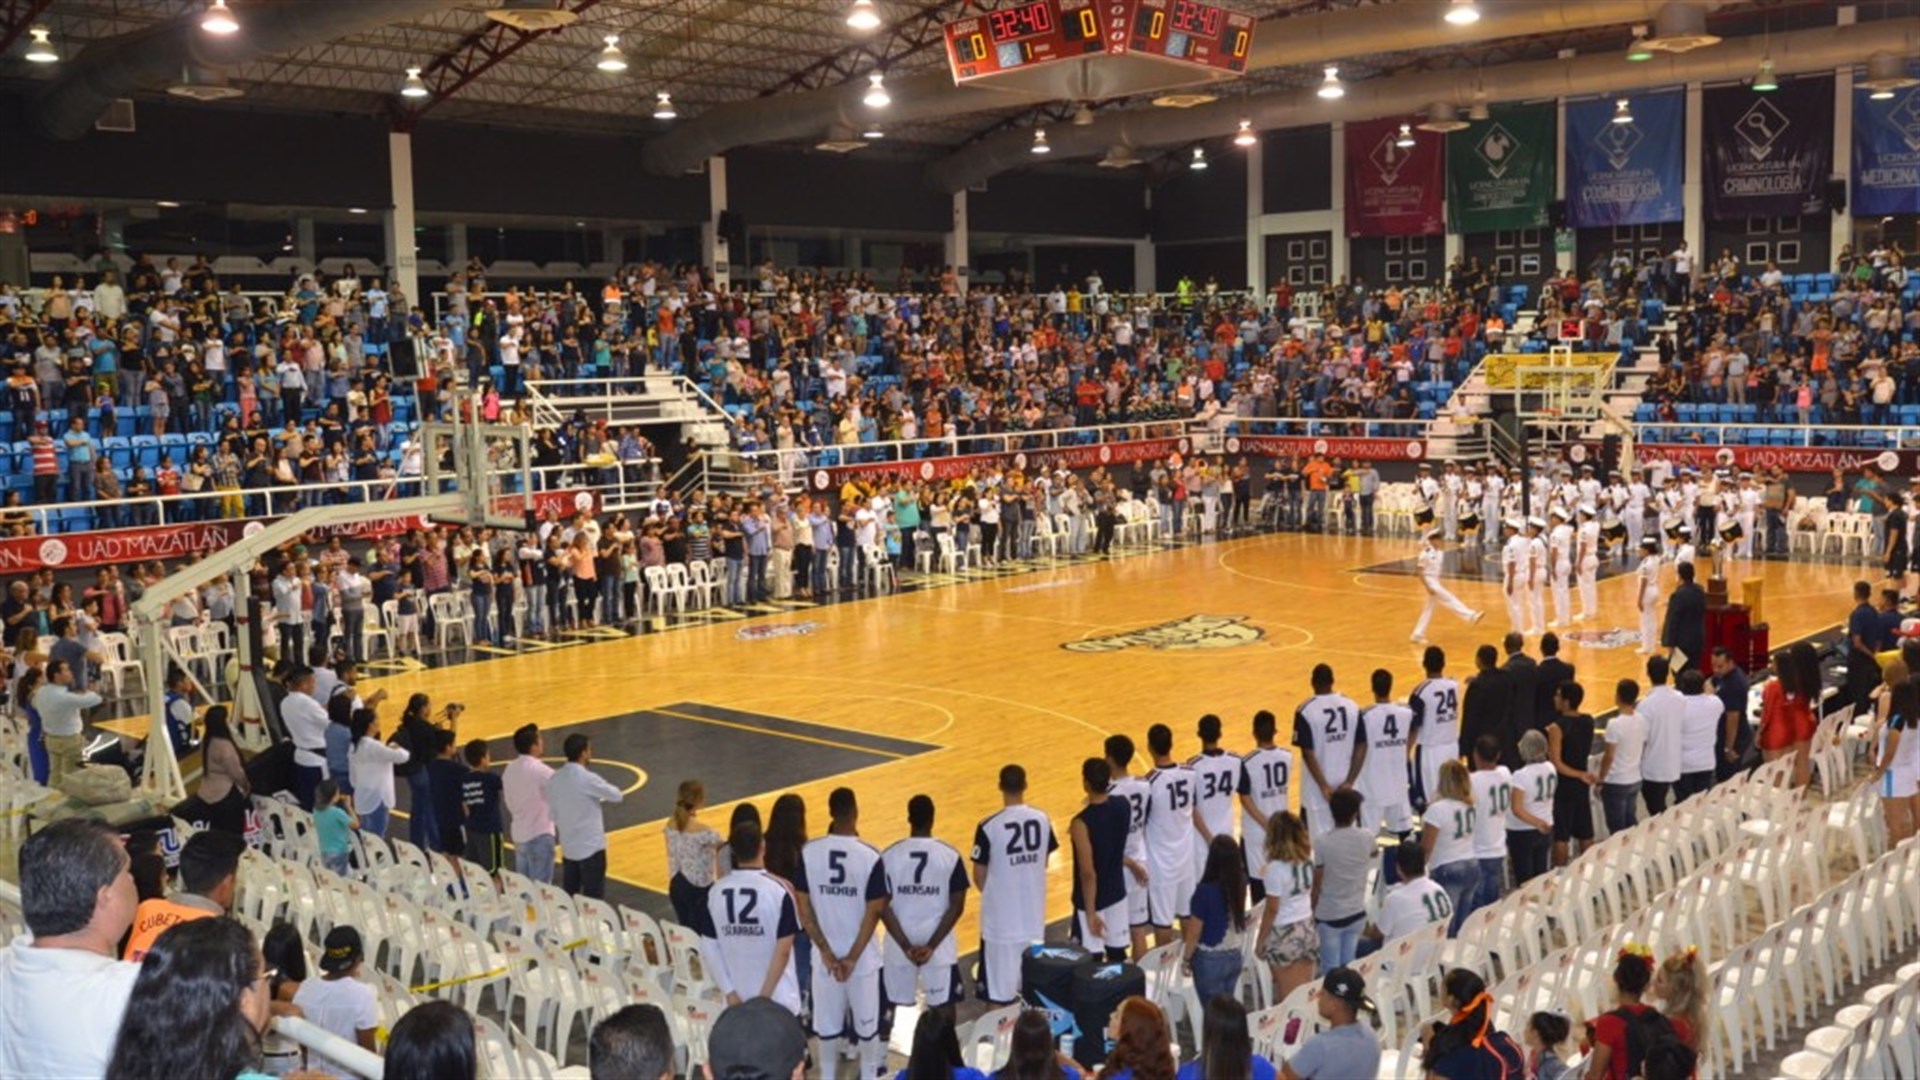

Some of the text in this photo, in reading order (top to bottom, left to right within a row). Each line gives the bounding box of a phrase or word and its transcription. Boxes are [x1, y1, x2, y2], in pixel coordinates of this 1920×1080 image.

[1080, 9, 1097, 38] 0
[1111, 0, 1124, 54] OBOS
[1150, 11, 1165, 39] 0
[971, 33, 987, 60] 0
[1234, 31, 1248, 57] 0
[1862, 167, 1918, 186] MEDICINA
[1744, 451, 1777, 467] UAD
[78, 538, 121, 561] UAD
[1433, 688, 1457, 715] 24
[1323, 706, 1348, 734] 21
[1383, 714, 1399, 738] 4
[1203, 770, 1233, 800] 34
[1262, 761, 1287, 789] 10
[1534, 773, 1557, 802] 10
[1166, 779, 1190, 811] 15
[1489, 783, 1510, 816] 10
[1004, 819, 1041, 855] 20
[1454, 806, 1476, 840] 10
[829, 850, 848, 885] 5
[909, 851, 929, 884] 7
[1290, 860, 1314, 896] 10
[721, 887, 760, 925] 12
[1422, 890, 1451, 923] 10
